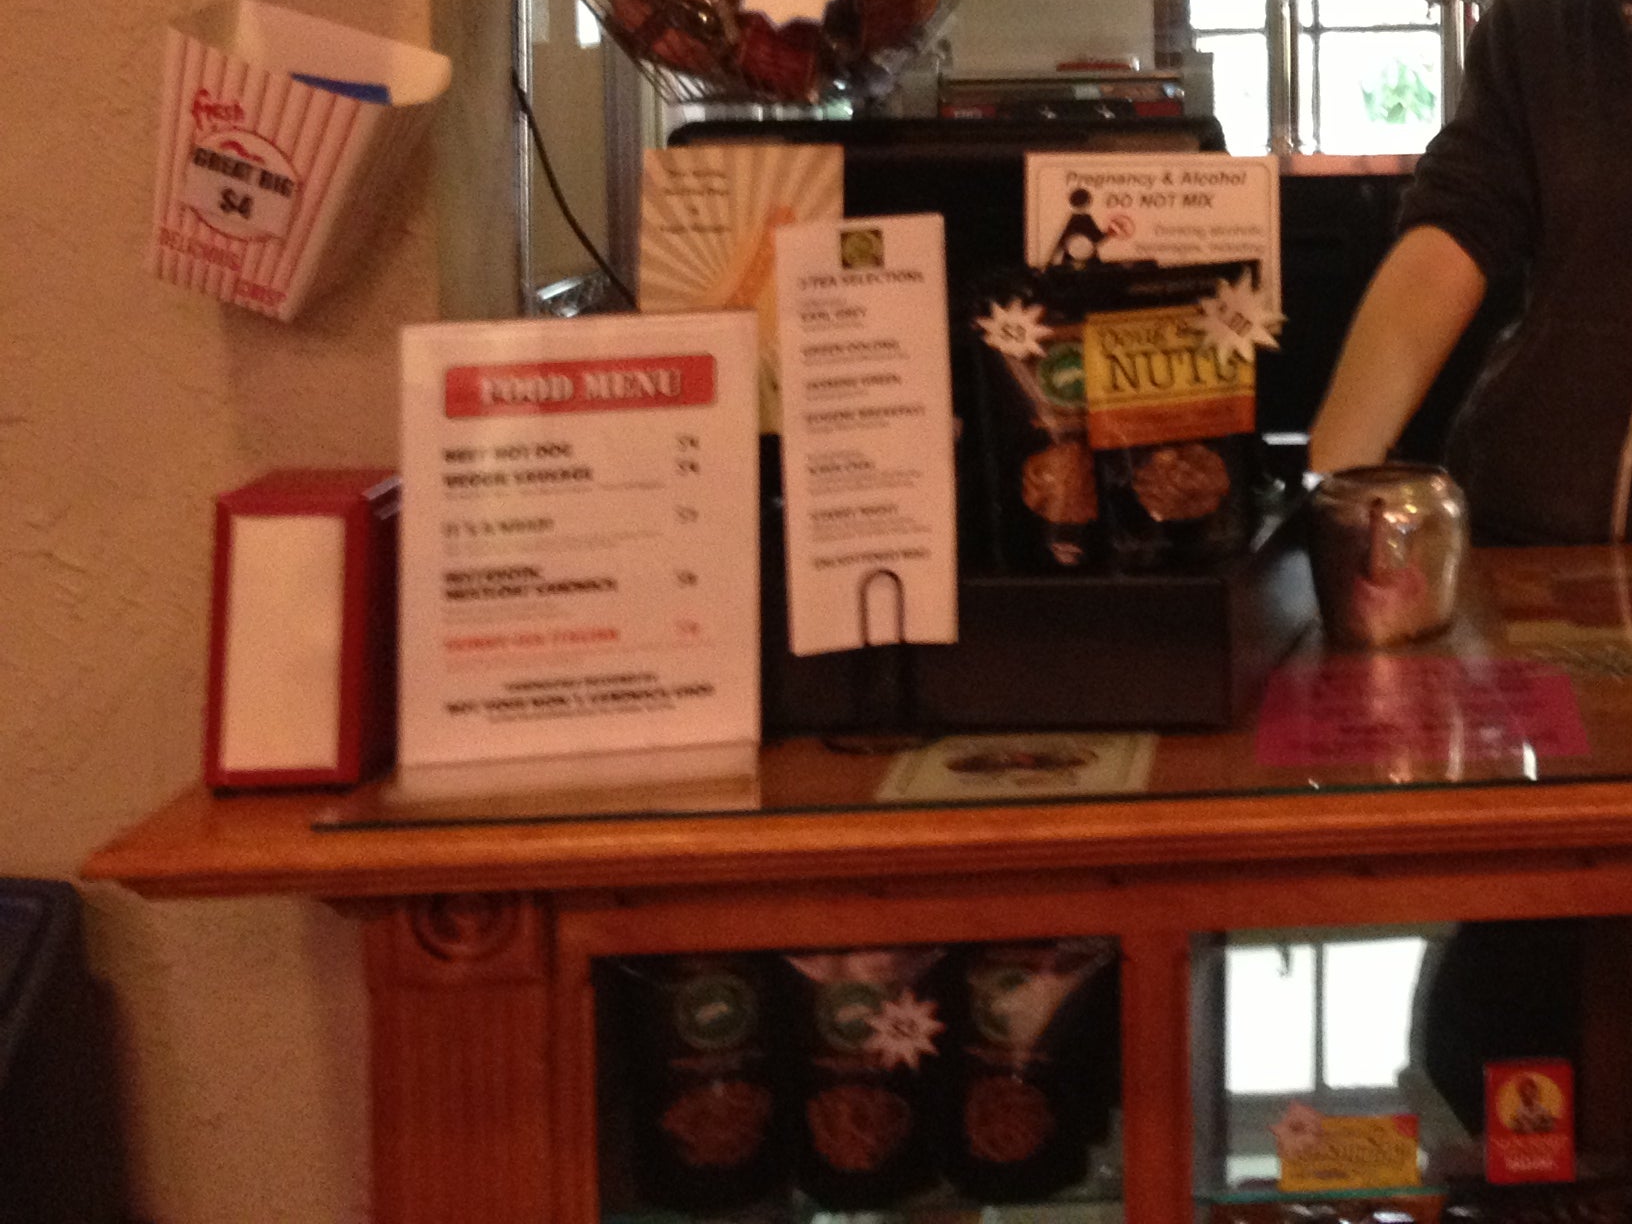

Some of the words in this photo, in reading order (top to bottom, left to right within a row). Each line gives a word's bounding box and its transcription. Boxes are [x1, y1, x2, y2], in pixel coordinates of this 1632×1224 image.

[1066, 172, 1154, 189] Pregnancy
[1159, 172, 1174, 186] &
[1181, 172, 1247, 186] Alcohol
[1106, 193, 1133, 208] DO
[1139, 192, 1176, 208] NOT
[1182, 192, 1214, 208] MIX
[482, 372, 574, 404] FOOD
[584, 368, 683, 400] MENU
